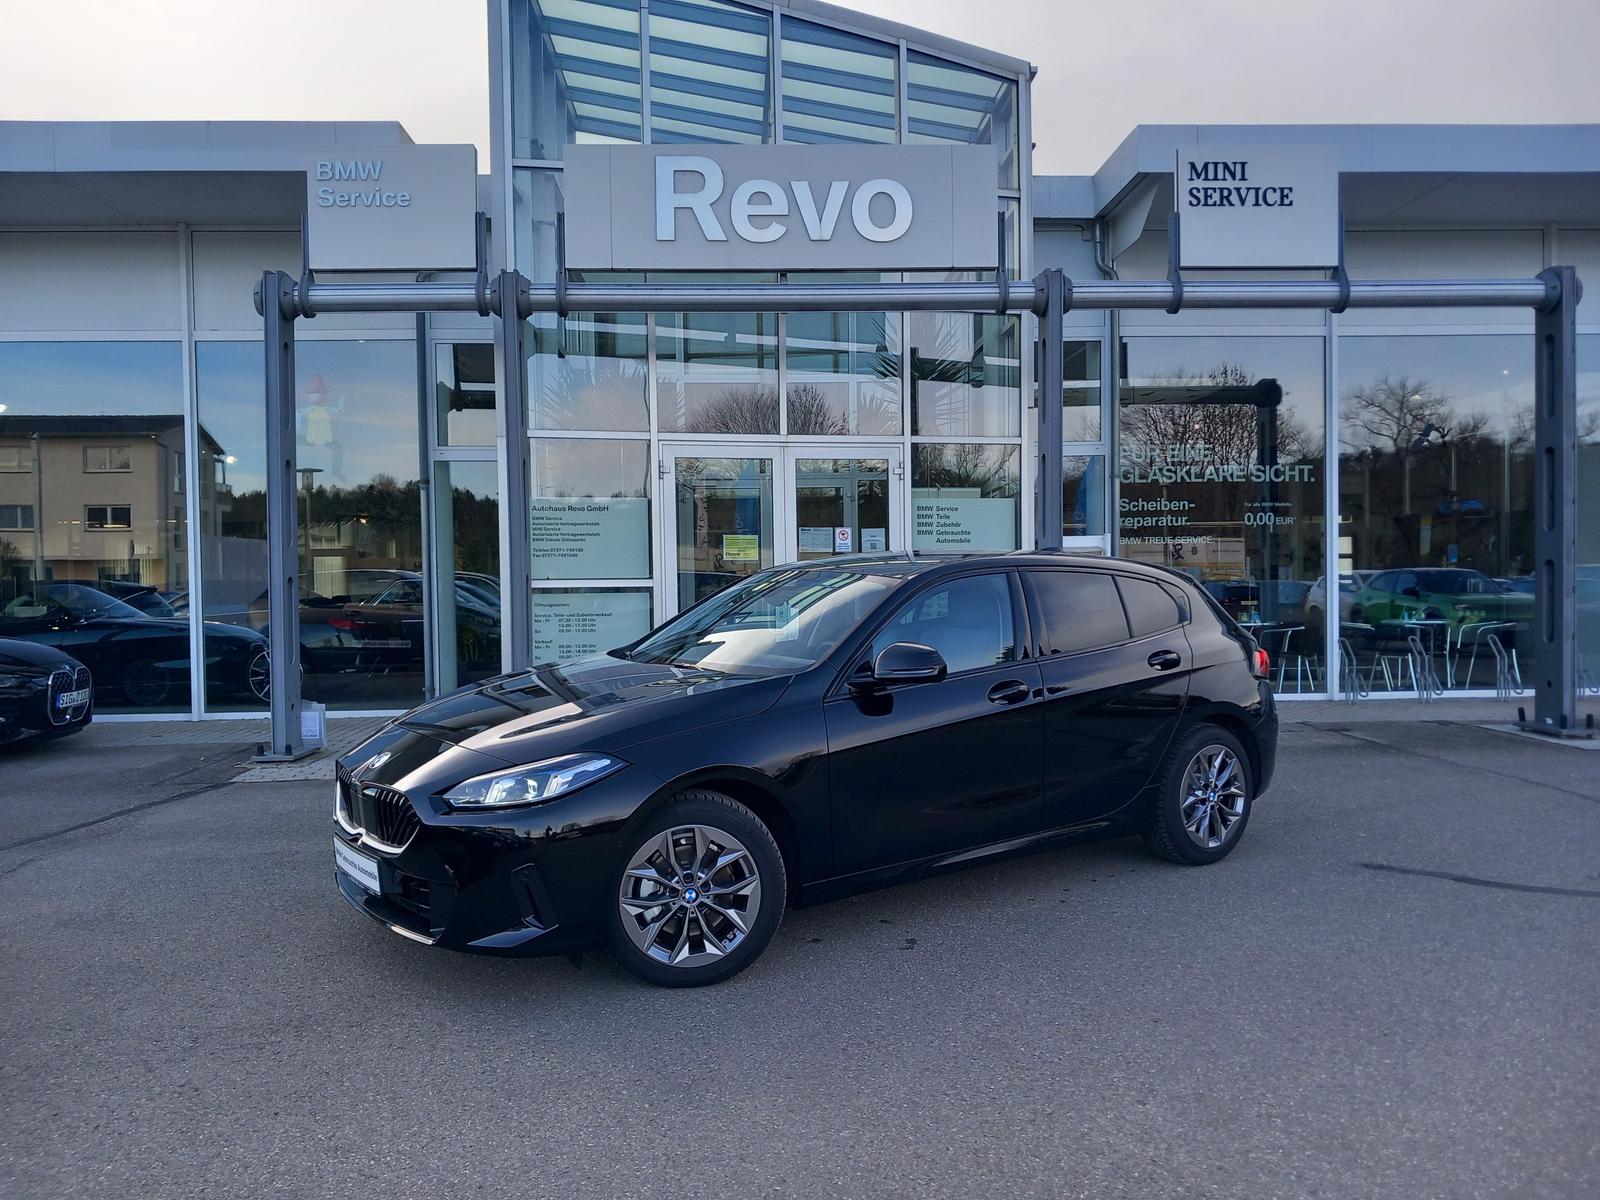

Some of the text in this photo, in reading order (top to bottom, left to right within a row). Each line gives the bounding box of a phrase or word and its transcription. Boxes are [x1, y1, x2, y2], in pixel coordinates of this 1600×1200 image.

[315, 159, 383, 182] BMW
[1188, 161, 1248, 182] MINI
[317, 186, 411, 208] Service
[655, 155, 913, 243] Revo
[1188, 186, 1294, 207] SERVICE
[1119, 464, 1315, 484] GLASKLARE SICHT.
[1119, 498, 1196, 512] Scheiben-
[1119, 514, 1191, 529] reparatur.
[1244, 512, 1275, 528] 0,00
[1119, 536, 1141, 545] BMW
[1143, 536, 1173, 545] TREUE
[60, 693, 73, 706] SIG
